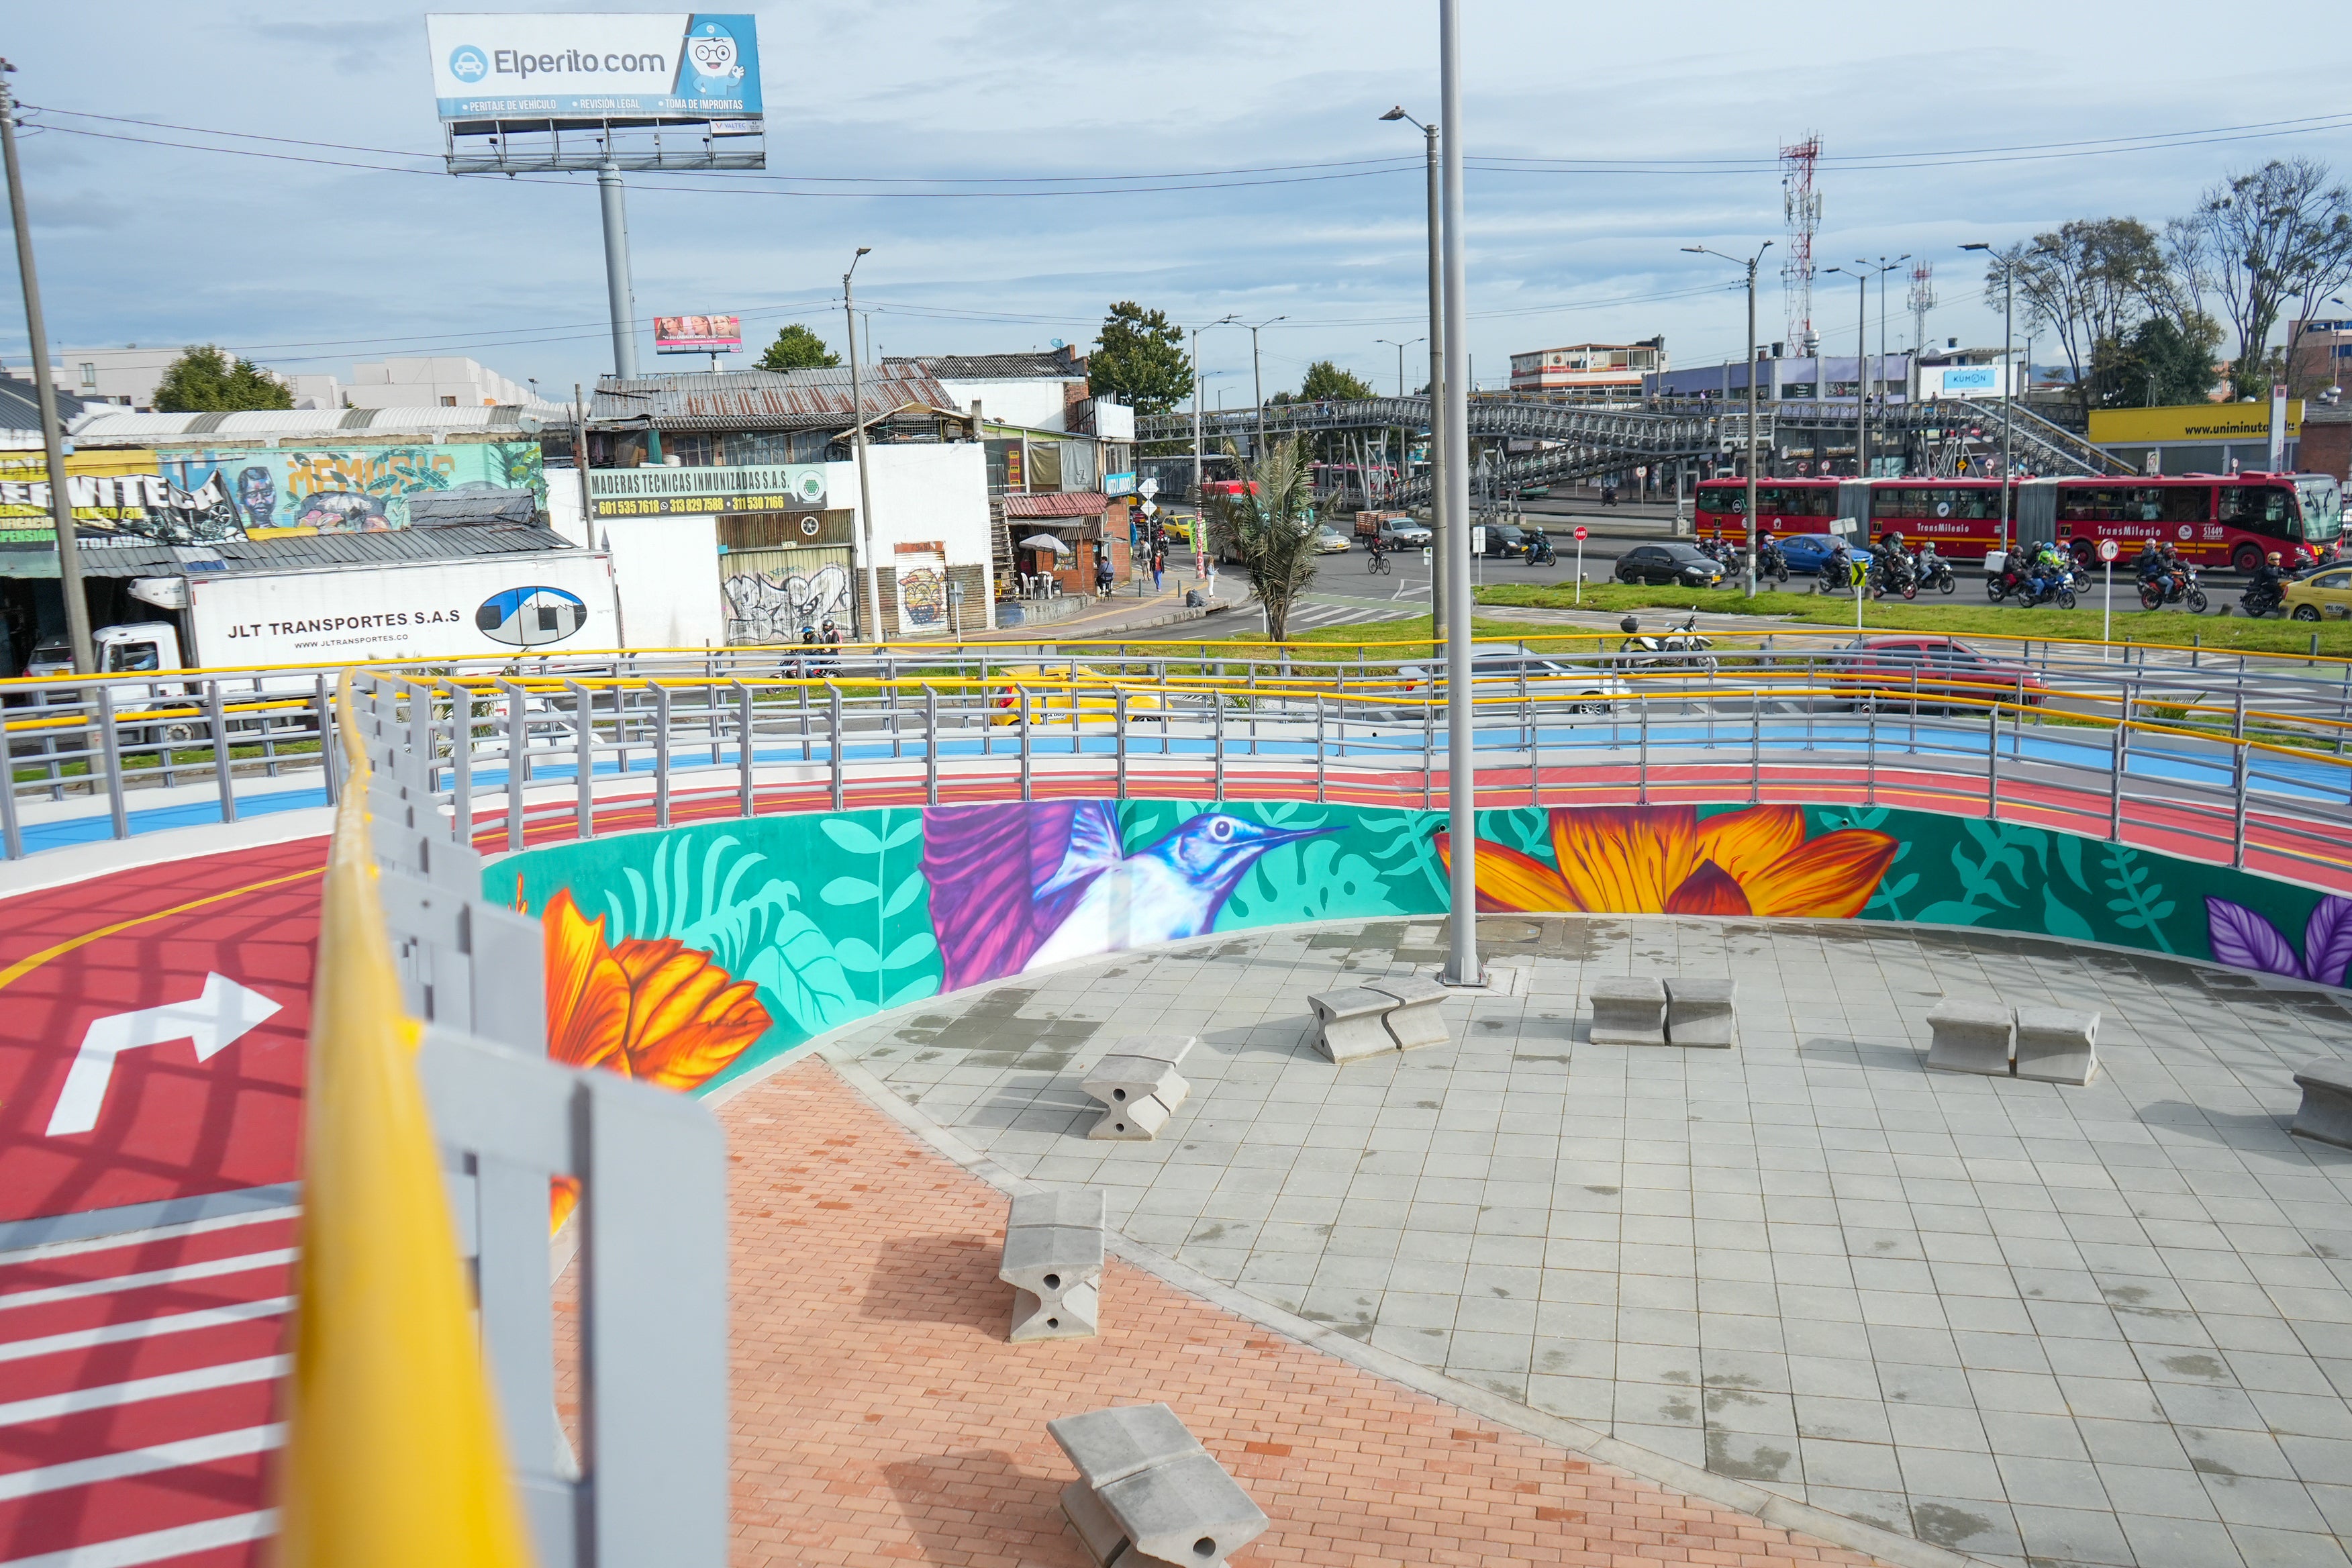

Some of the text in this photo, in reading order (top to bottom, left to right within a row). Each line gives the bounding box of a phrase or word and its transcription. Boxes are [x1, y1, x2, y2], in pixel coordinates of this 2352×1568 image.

[494, 48, 665, 79] Elperito.com
[470, 98, 556, 112] PERITAJE DE VEHÍCULO
[580, 97, 640, 109] REVISIÓN LEGAL
[665, 99, 743, 110] TOMA DE IMPRONTAS
[1953, 374, 1986, 383] KUMON
[591, 471, 790, 495] MADERAS TÉCNICAS INMUNIZADAS S.A.S.
[0, 471, 224, 510] ERVITECH
[599, 499, 660, 515] 601 535 7618
[669, 497, 724, 513] 313 829 7588
[732, 495, 784, 510] 311 530 7166
[1917, 522, 1970, 533] TransMilenio
[2097, 525, 2161, 536] TransMilenio
[2203, 526, 2223, 536] S1449
[228, 609, 460, 638] JLT TRANSPORTES S.A.S
